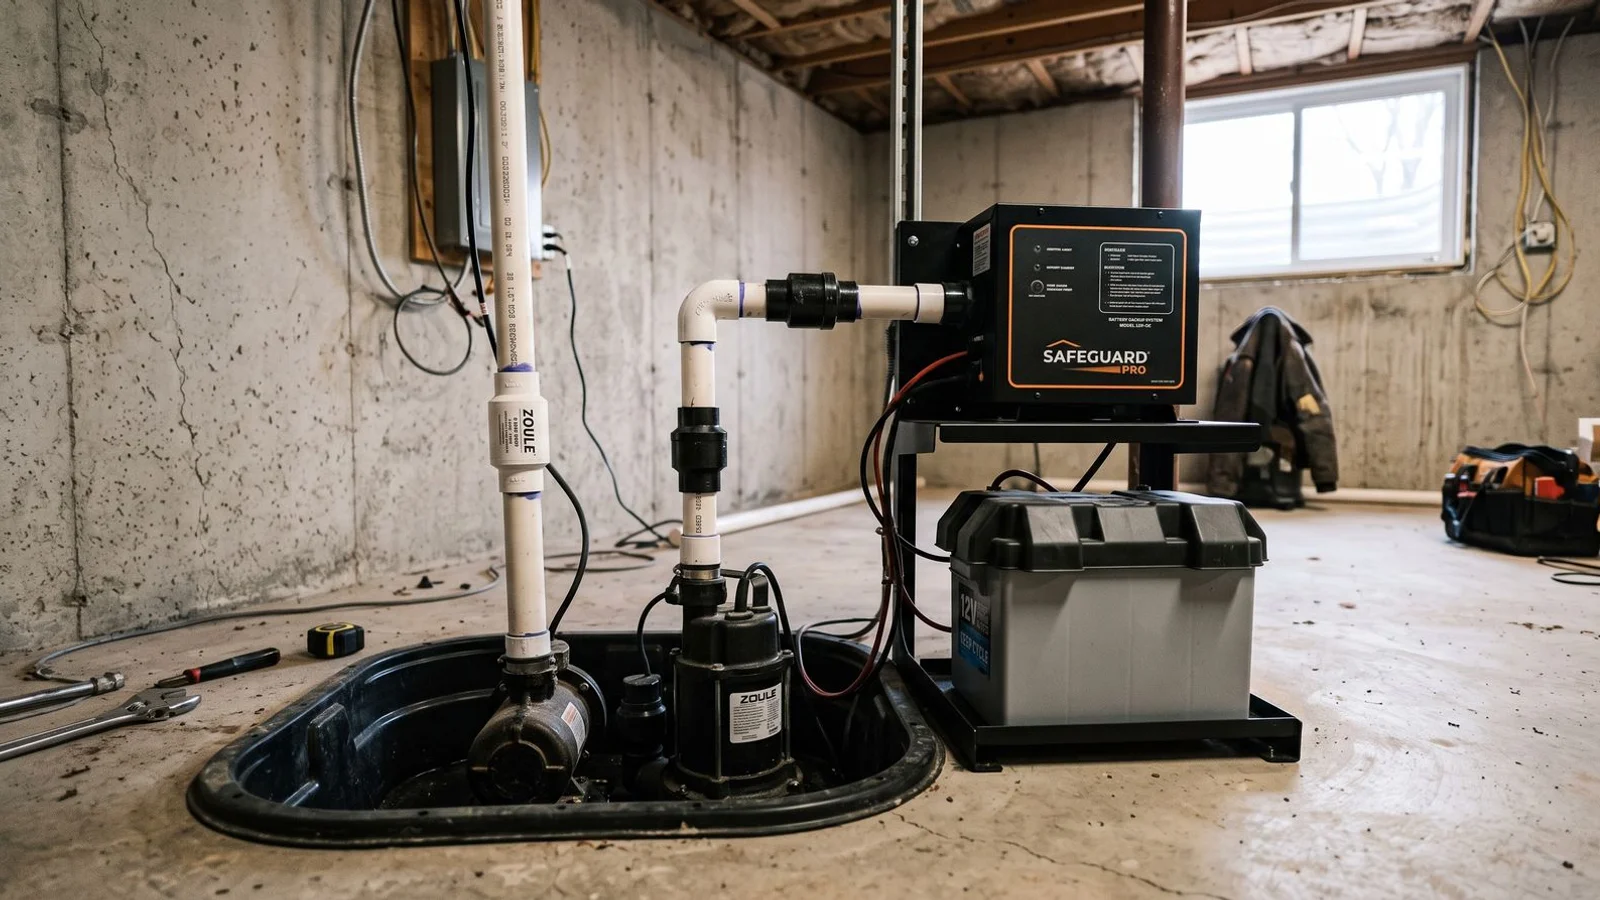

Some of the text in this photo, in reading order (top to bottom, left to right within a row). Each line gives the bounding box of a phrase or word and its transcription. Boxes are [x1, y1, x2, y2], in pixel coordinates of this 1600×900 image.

[1043, 350, 1148, 364] SAFEGUARD
[1121, 365, 1147, 375] PRO
[523, 409, 535, 454] ZOULE
[961, 594, 977, 626] 12V
[973, 640, 988, 664] CYCLE
[740, 688, 777, 704] ZOULE
